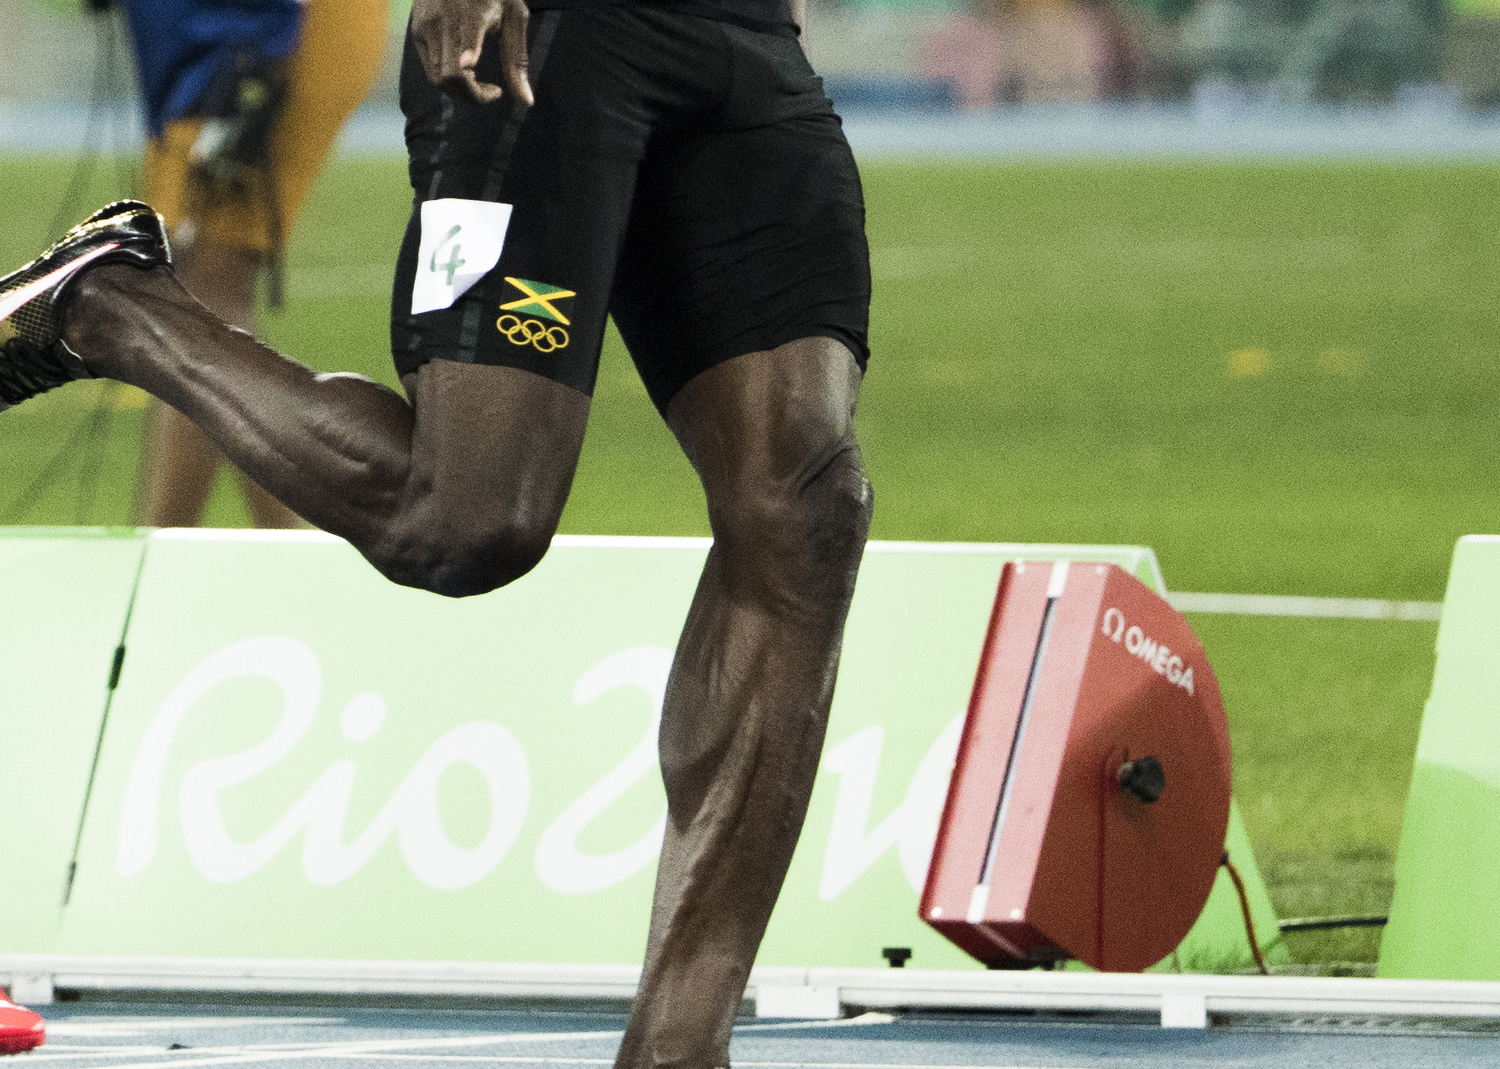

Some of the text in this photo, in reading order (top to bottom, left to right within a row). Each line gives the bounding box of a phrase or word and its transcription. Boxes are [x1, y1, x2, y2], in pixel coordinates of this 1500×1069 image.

[430, 224, 466, 286] 4
[1125, 625, 1194, 696] OMEGA
[115, 634, 967, 902] Rio21
